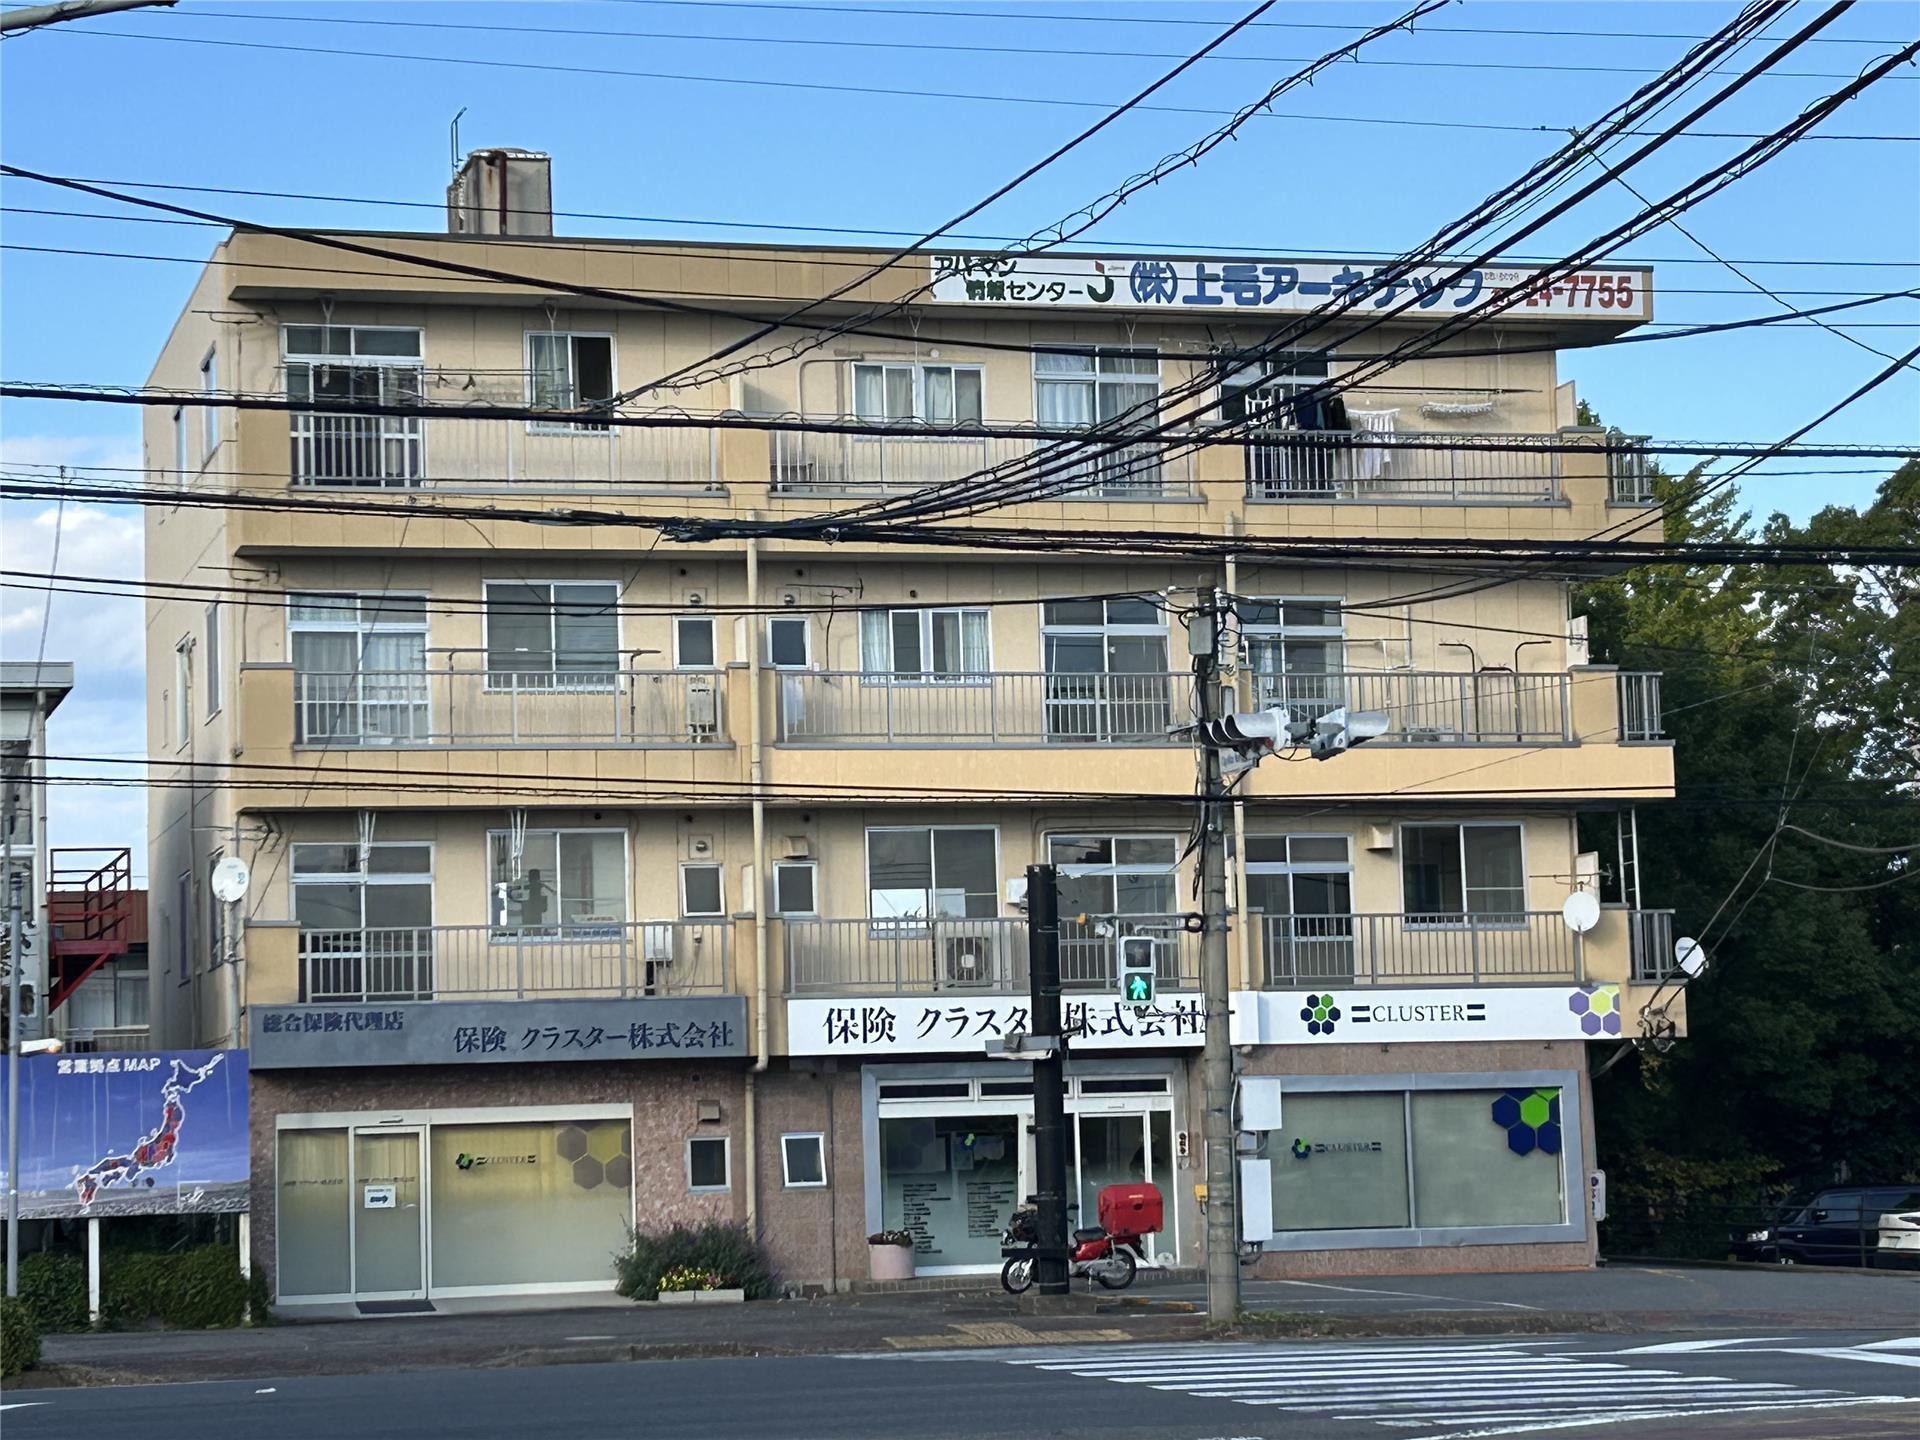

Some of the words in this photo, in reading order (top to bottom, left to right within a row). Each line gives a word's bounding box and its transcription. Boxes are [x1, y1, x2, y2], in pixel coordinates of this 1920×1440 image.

[262, 1011, 404, 1033] 総合保険代理店
[822, 1006, 897, 1044] 保険
[916, 1001, 1205, 1040] クラスタ株式会社
[1373, 1004, 1465, 1023] CLUSTER
[453, 1025, 508, 1054] 保険
[520, 1020, 736, 1051] クラスター株式会社
[124, 1057, 161, 1072] MAP
